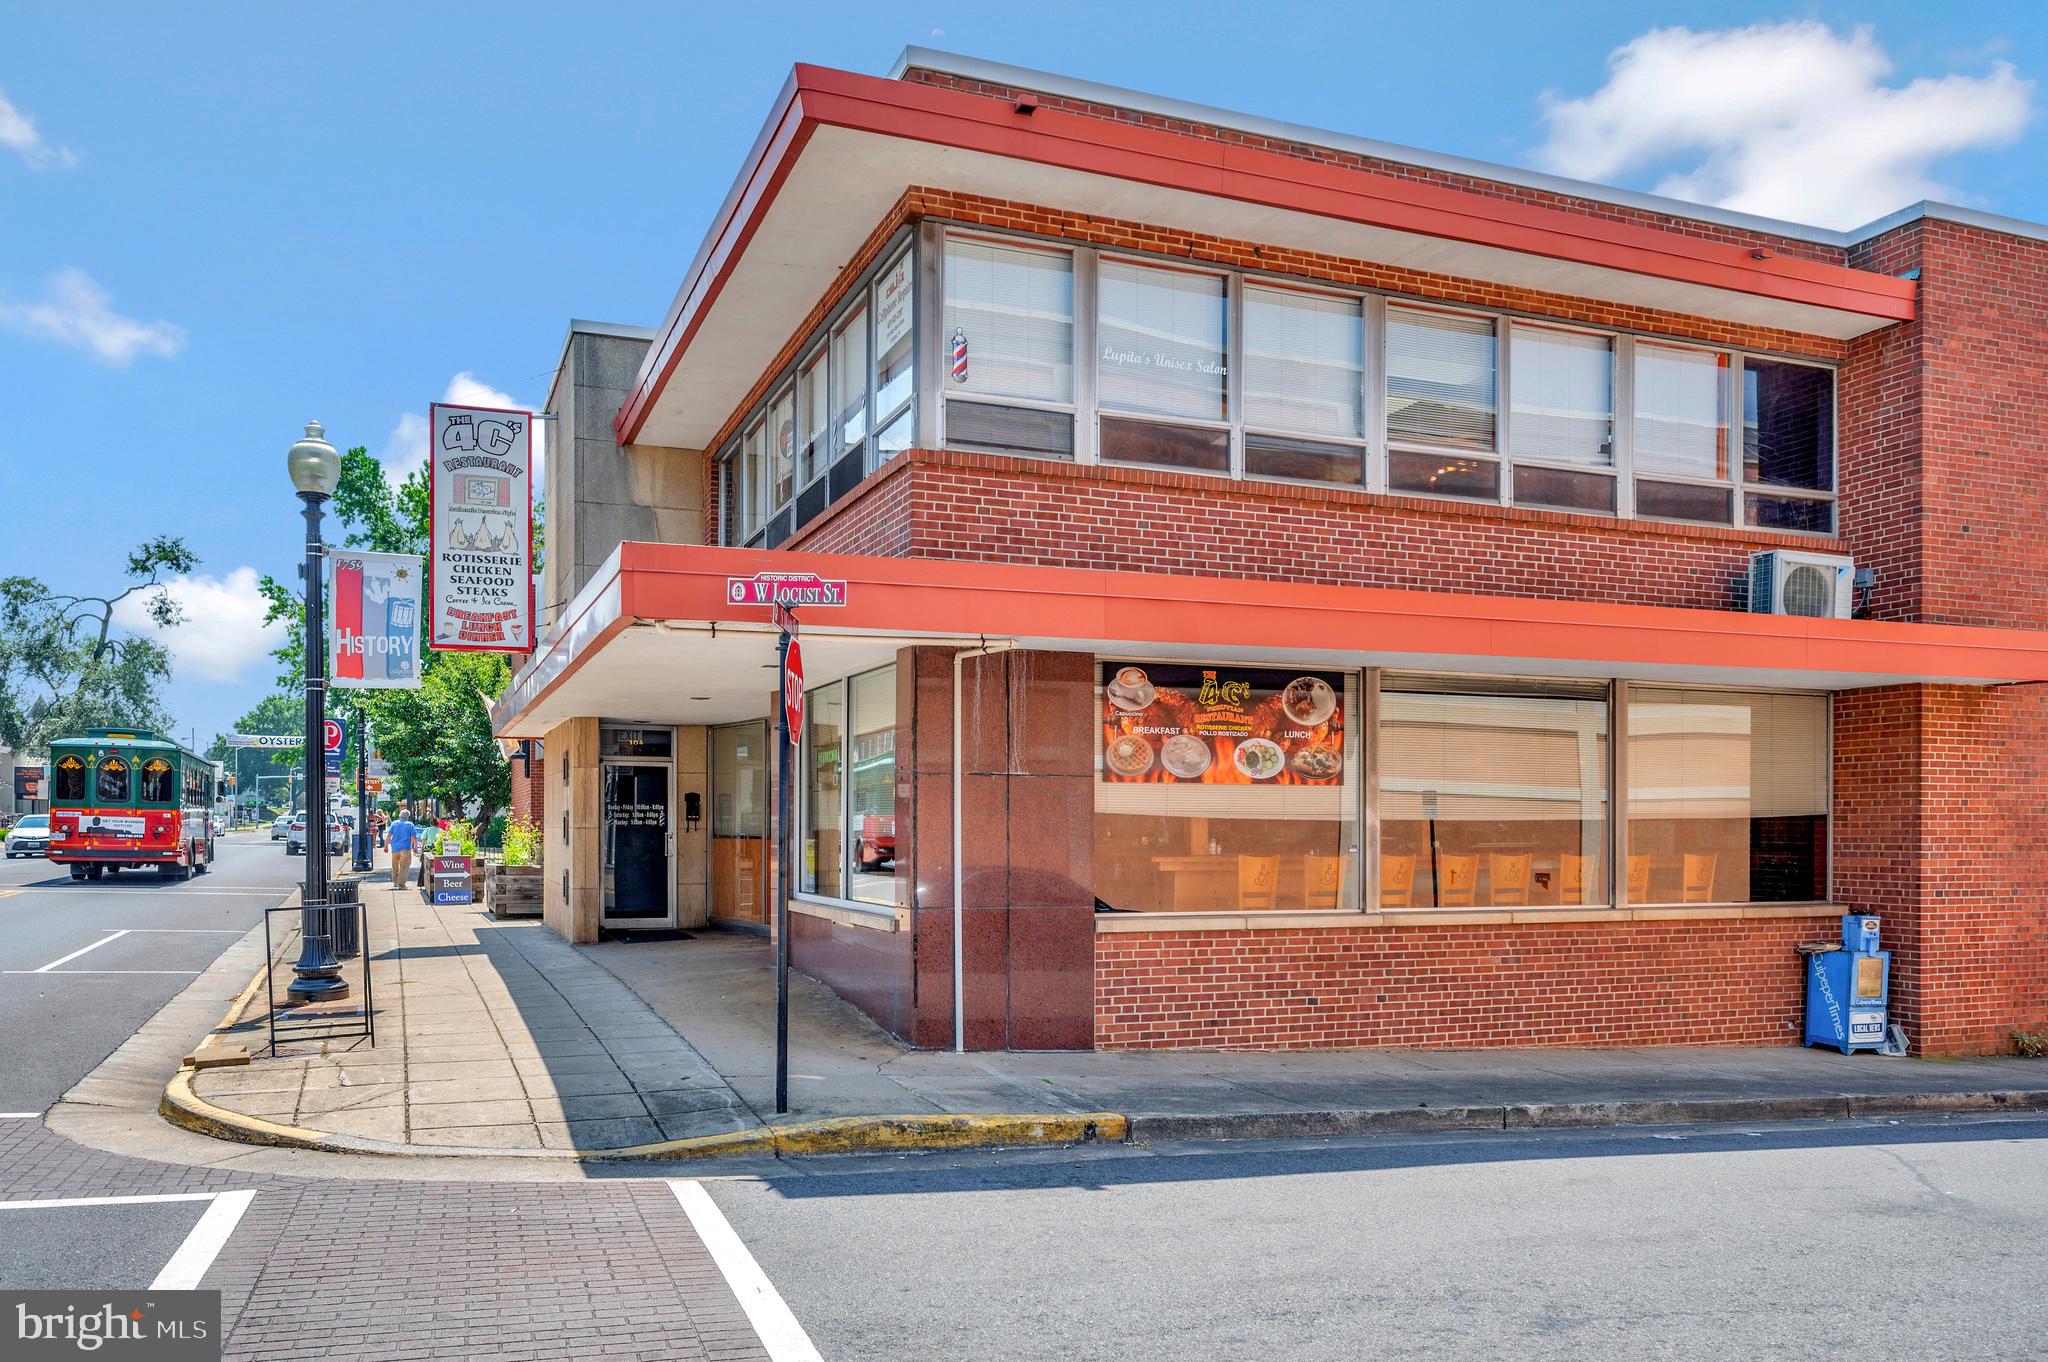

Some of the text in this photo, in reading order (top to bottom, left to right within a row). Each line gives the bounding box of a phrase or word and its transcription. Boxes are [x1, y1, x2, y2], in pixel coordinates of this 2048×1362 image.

[1102, 346, 1228, 375] Lupita's Unisex Salon
[449, 415, 472, 425] THE
[443, 456, 523, 478] RESTAURANT
[336, 559, 364, 571] 1759
[442, 553, 522, 566] ROTISSERIE
[453, 565, 512, 576] CHICKEN
[450, 575, 514, 586] SEAFOOD
[761, 574, 787, 582] HISTORIC
[457, 586, 508, 597] STEAKS
[753, 582, 769, 601] W
[773, 583, 822, 603] LOCUST
[446, 606, 518, 622] BREAKFAST
[461, 620, 502, 632] LUNCH
[336, 627, 413, 656] HISTORY
[458, 630, 505, 642] DINNER
[786, 668, 803, 712] STOP
[1115, 710, 1144, 718] Capuccino
[1194, 712, 1254, 724] RESTAURANT
[324, 725, 339, 747] P
[1133, 726, 1181, 736] BREAKFAST
[1284, 730, 1312, 739] LUNCH
[441, 860, 465, 869] Wine
[443, 880, 463, 888] Beer
[438, 893, 469, 902] Cheese
[1853, 1023, 1881, 1033] LOCAL NEWS
